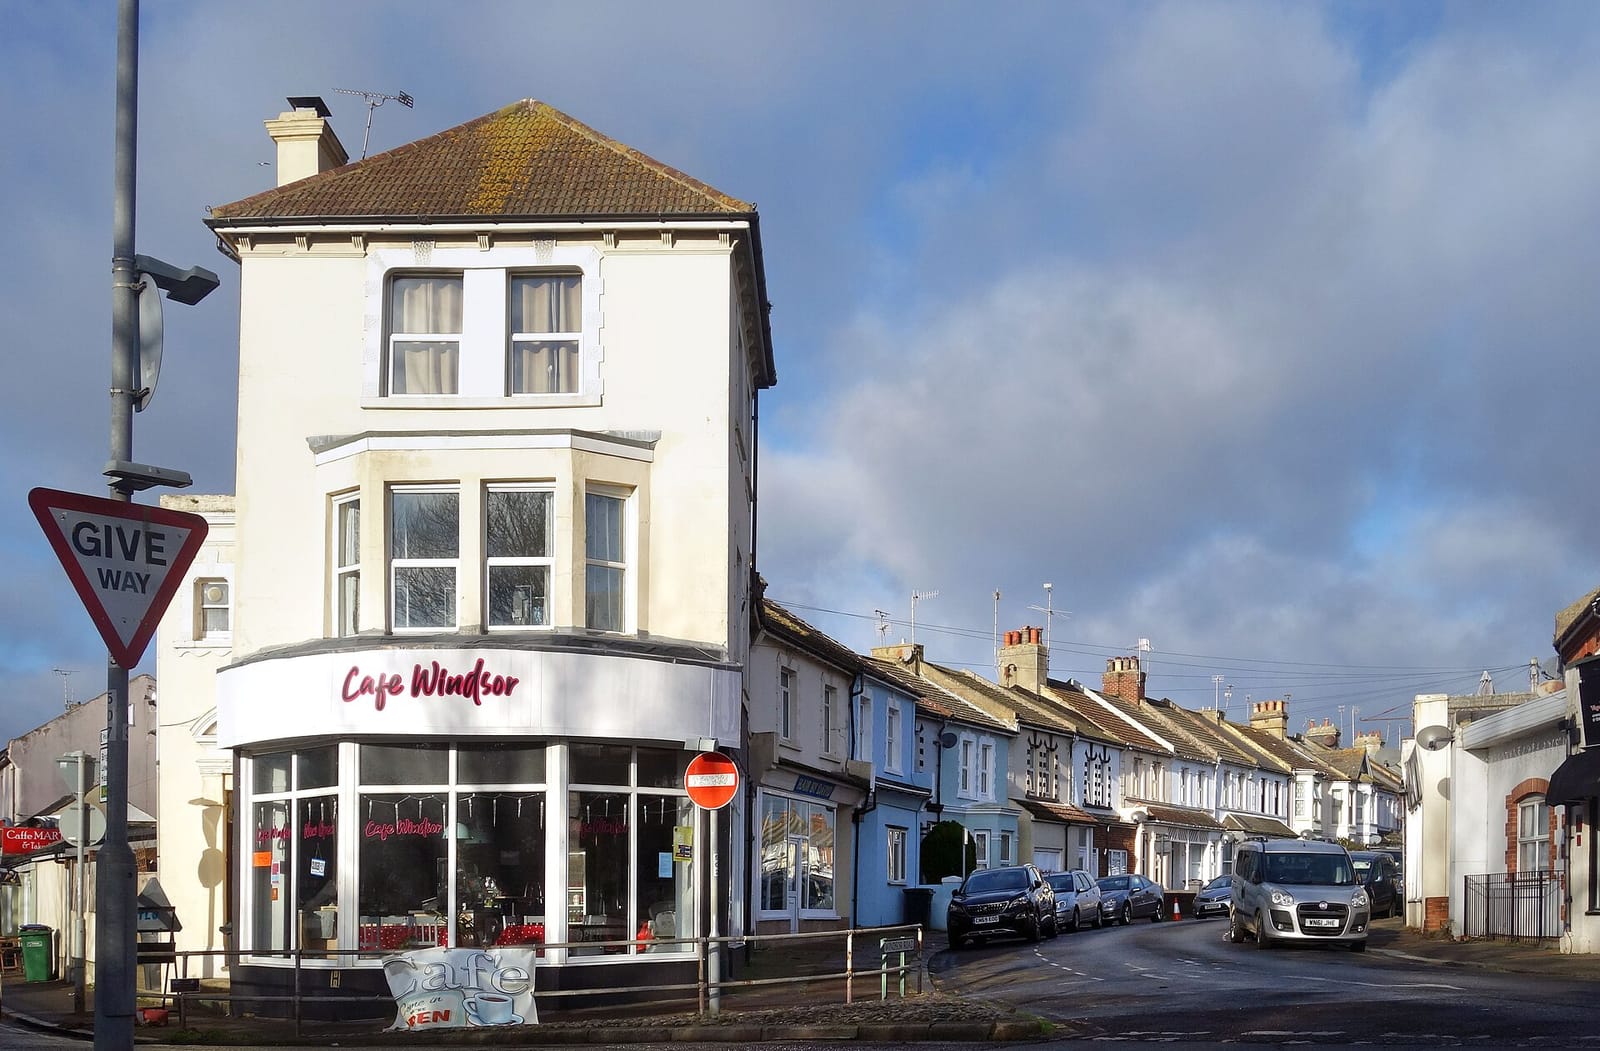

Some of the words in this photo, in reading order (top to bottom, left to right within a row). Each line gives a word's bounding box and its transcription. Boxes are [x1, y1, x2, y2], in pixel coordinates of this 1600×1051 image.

[72, 521, 167, 567] GIVE
[97, 567, 151, 594] WAY
[341, 655, 405, 712] Cafe
[410, 657, 520, 706] Windsor
[6, 830, 33, 840] Caffe
[365, 820, 394, 841] Cafe
[396, 817, 442, 838] Windsor
